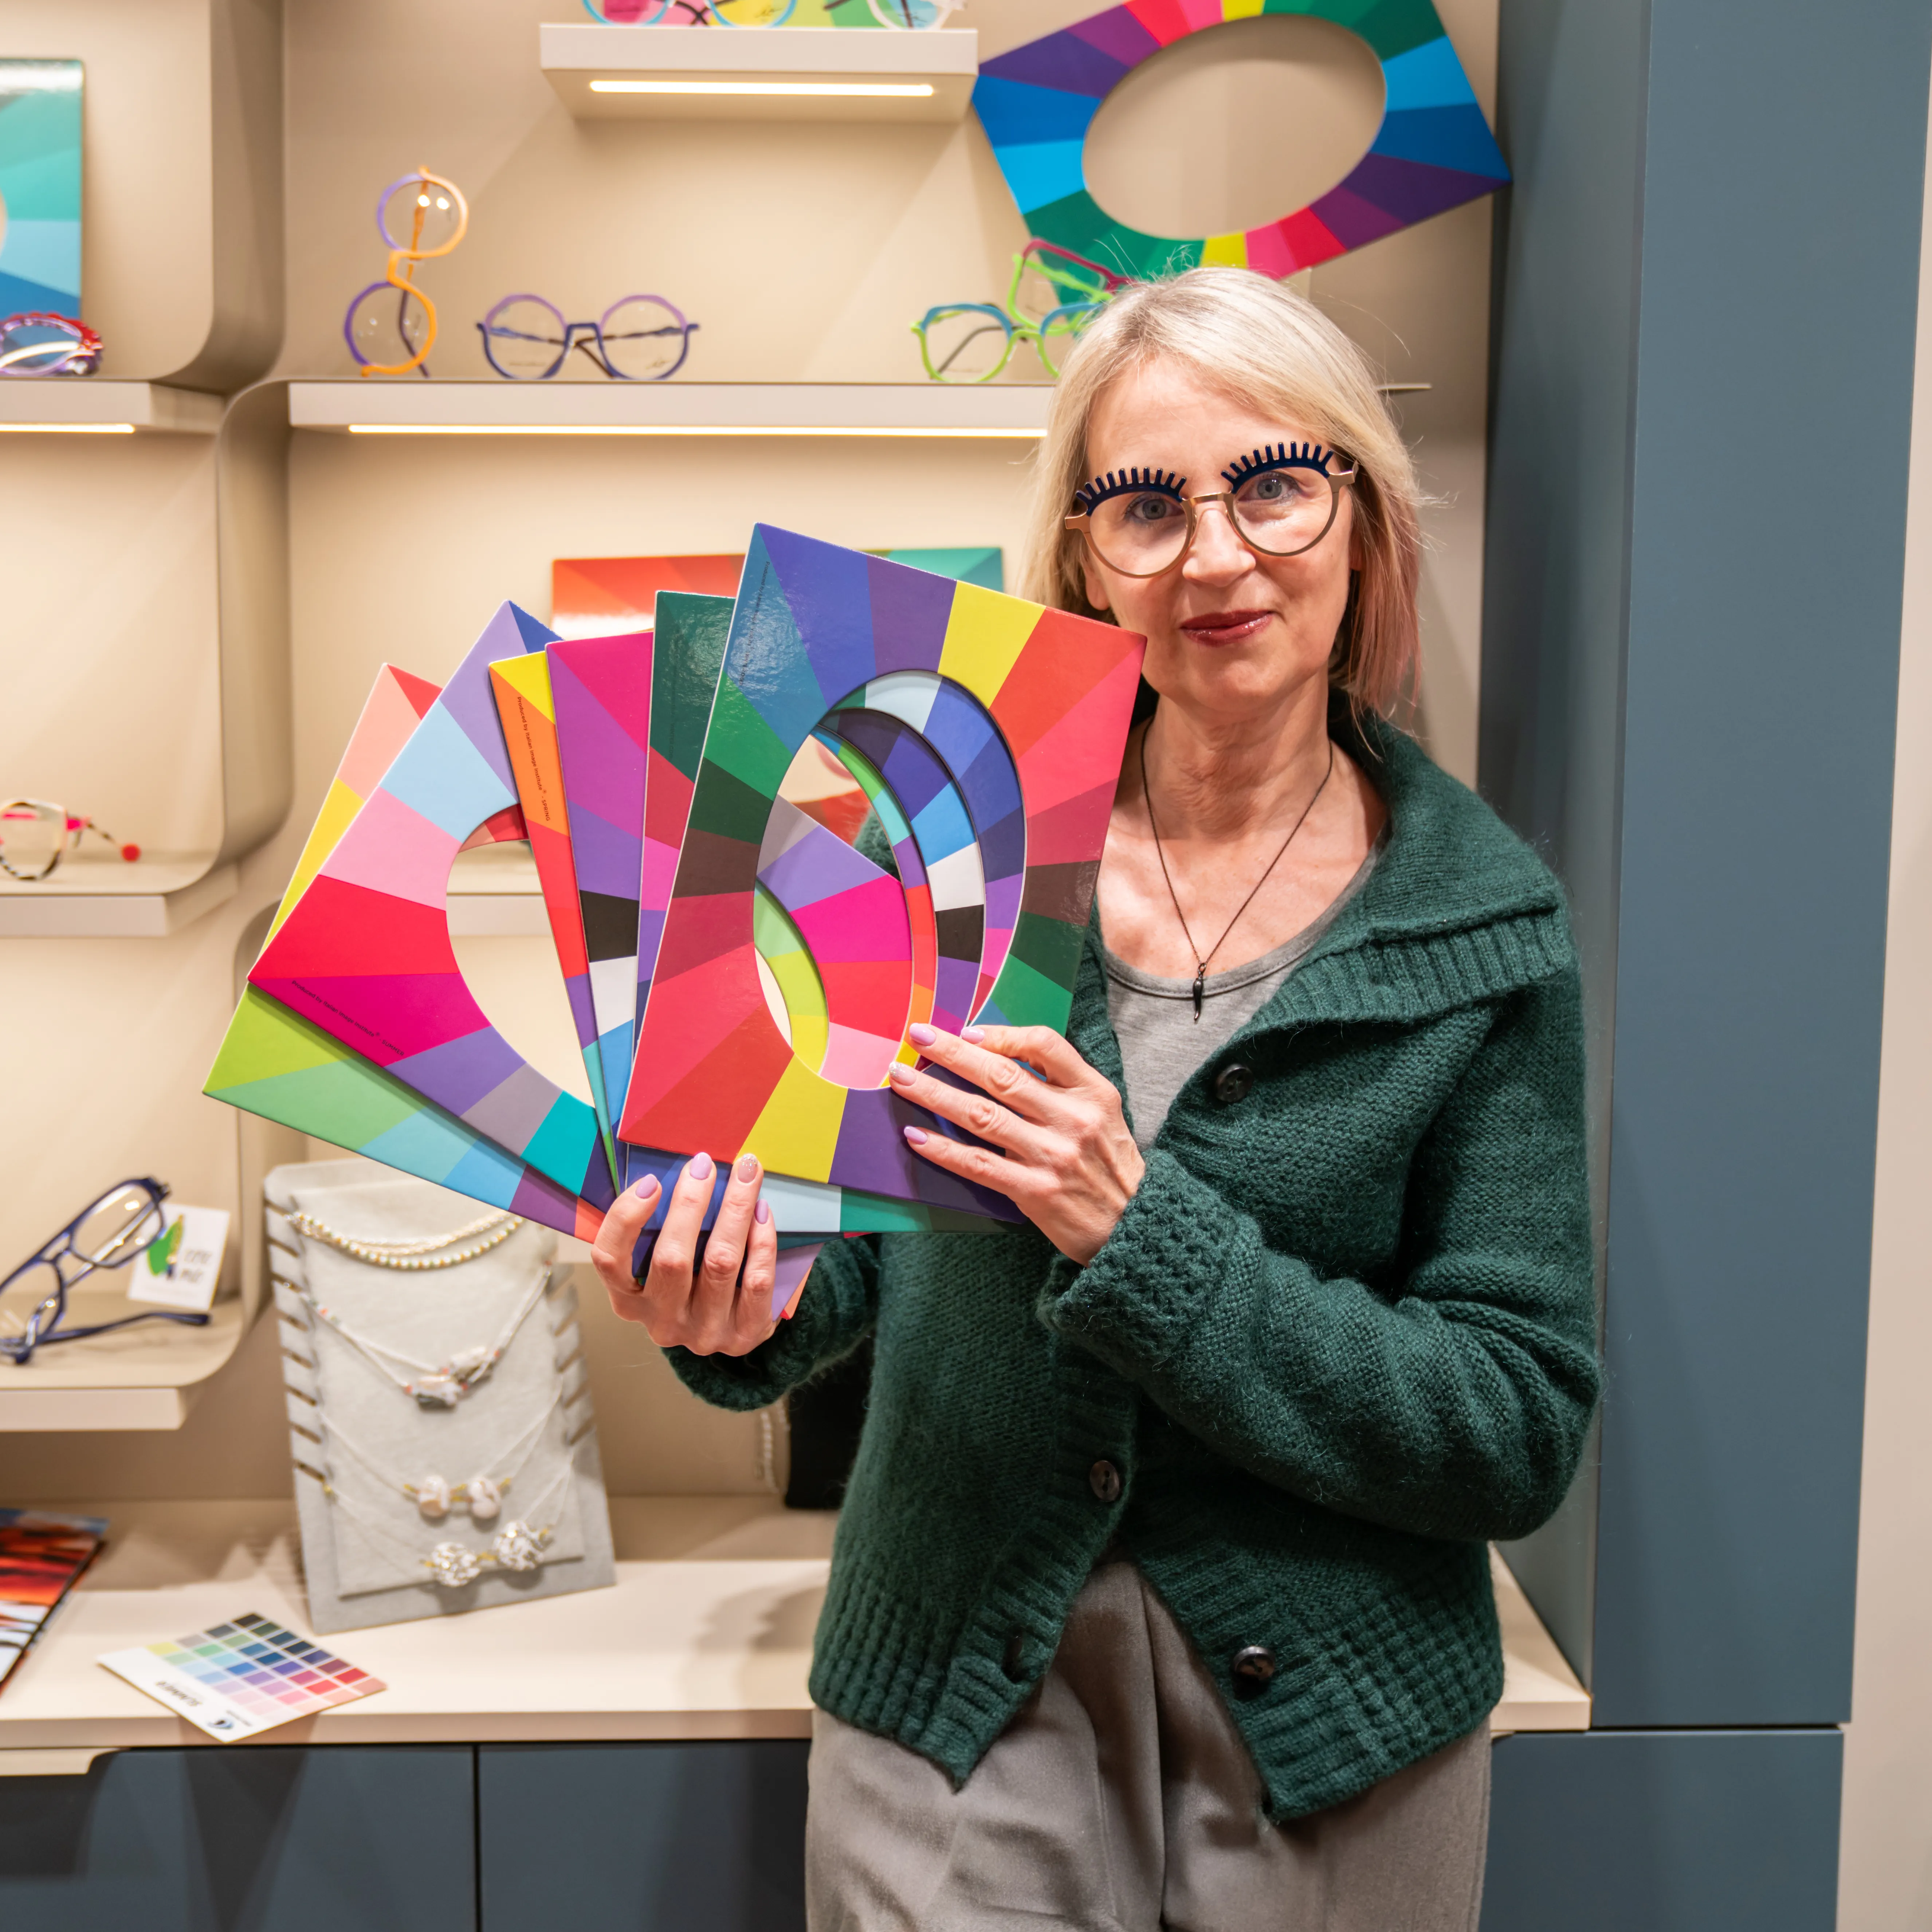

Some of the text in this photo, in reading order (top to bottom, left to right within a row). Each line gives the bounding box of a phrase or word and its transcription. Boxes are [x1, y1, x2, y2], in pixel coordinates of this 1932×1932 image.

[762, 562, 770, 585] Produced
[517, 696, 526, 723] Produced
[542, 800, 550, 821] SPRING
[292, 980, 316, 998] Produced
[323, 1001, 338, 1013] Italian
[339, 1012, 354, 1023] Image
[382, 1040, 404, 1056] SUMMER
